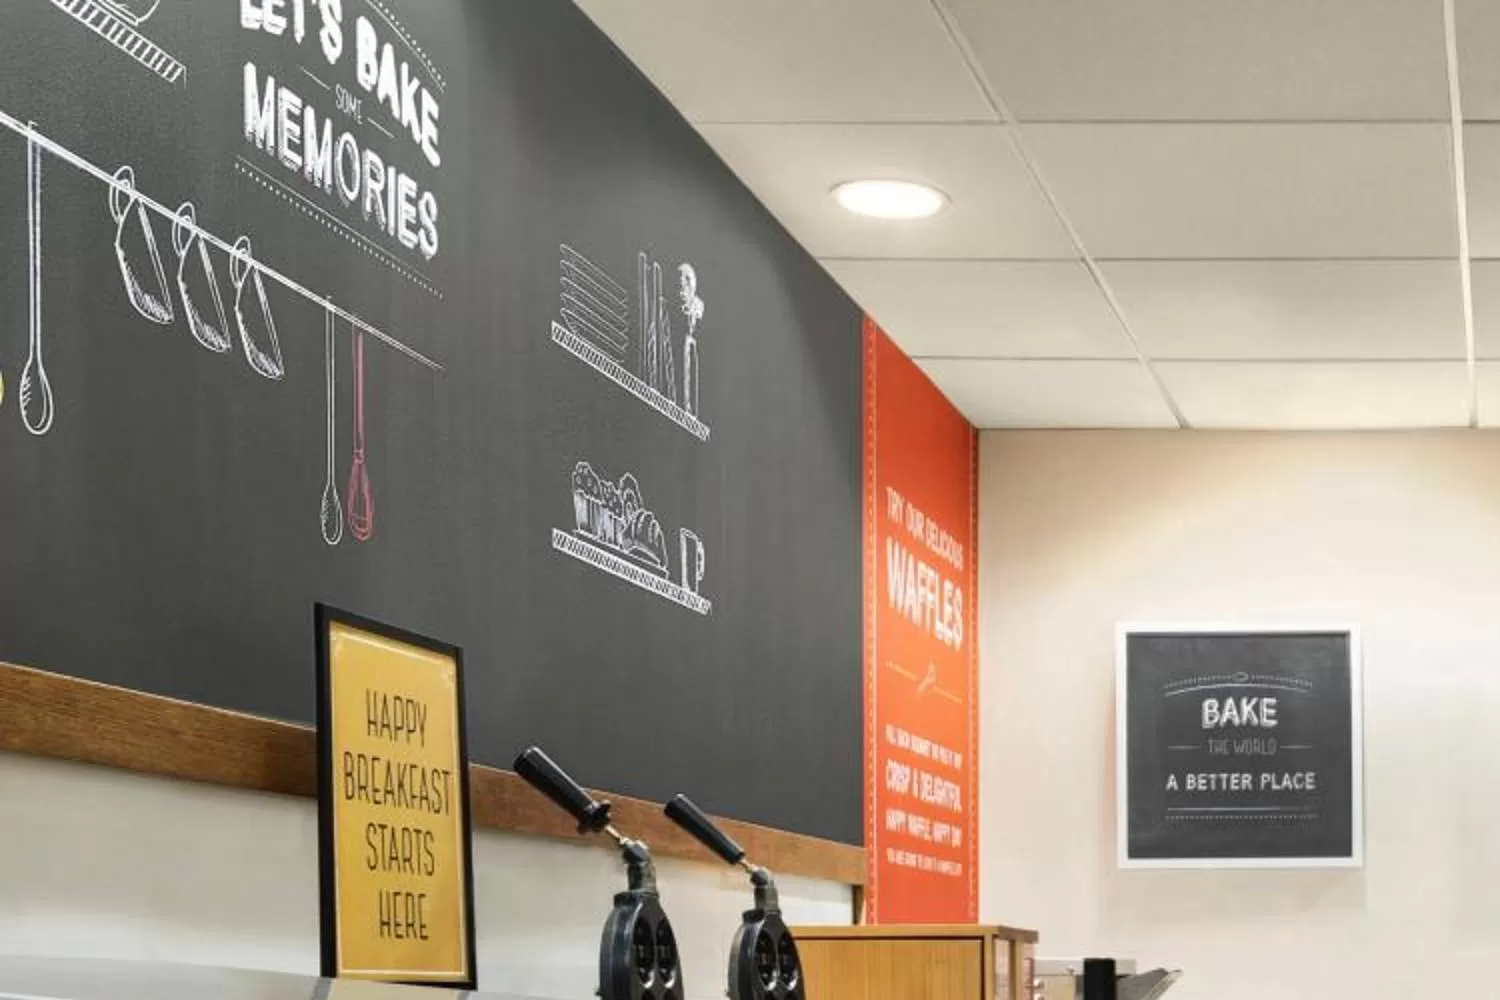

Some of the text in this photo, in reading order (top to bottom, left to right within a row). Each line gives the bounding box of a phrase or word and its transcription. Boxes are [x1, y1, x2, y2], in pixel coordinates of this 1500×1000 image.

[240, 0, 441, 168] ETS BAKE
[335, 83, 363, 125] SOME
[243, 61, 439, 261] MEMORIES
[886, 486, 905, 523] TRY
[906, 502, 925, 541] OUR
[886, 535, 964, 652] WAFFLES
[365, 687, 427, 748] HAPPY
[1201, 697, 1279, 729] BAKE
[1208, 738, 1278, 755] THE WORLD
[343, 751, 452, 816] BREAKFAST
[1165, 772, 1317, 791] A BETTER PLACE
[365, 823, 435, 877] STARTS
[378, 891, 429, 941] HERE
